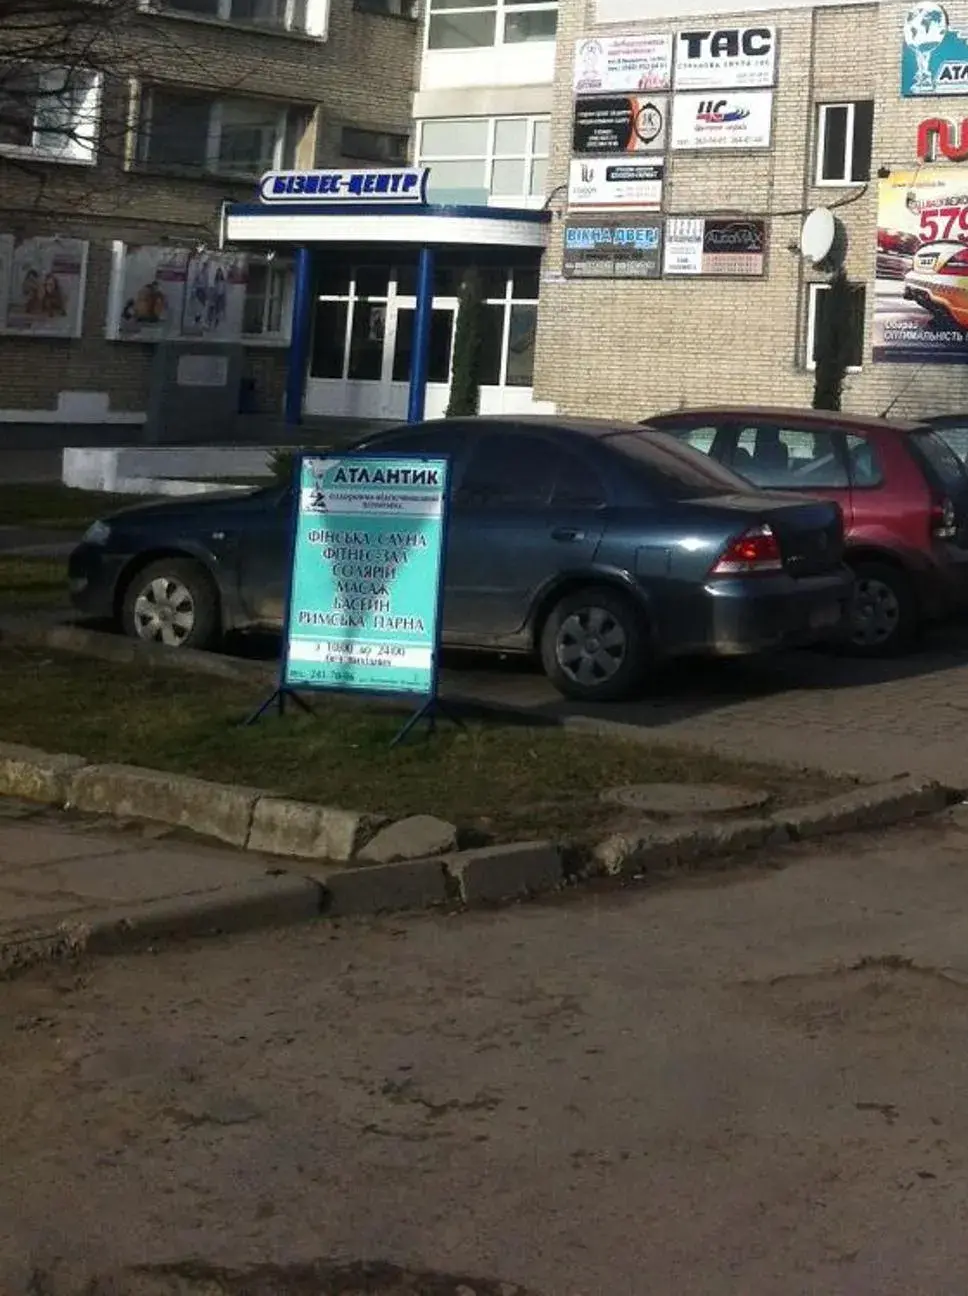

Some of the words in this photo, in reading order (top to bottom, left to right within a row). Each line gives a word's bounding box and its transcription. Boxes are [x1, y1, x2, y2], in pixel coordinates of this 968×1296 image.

[681, 28, 771, 59] ТАС
[273, 174, 418, 195] БІЗНЕС-ЦЕНТР
[334, 468, 438, 484] АТЛАНТИК
[309, 529, 370, 545] ФІНСЬКА
[378, 532, 427, 547] САУНА
[337, 581, 389, 595] МАСАЖ
[374, 616, 424, 631] ПАРНА
